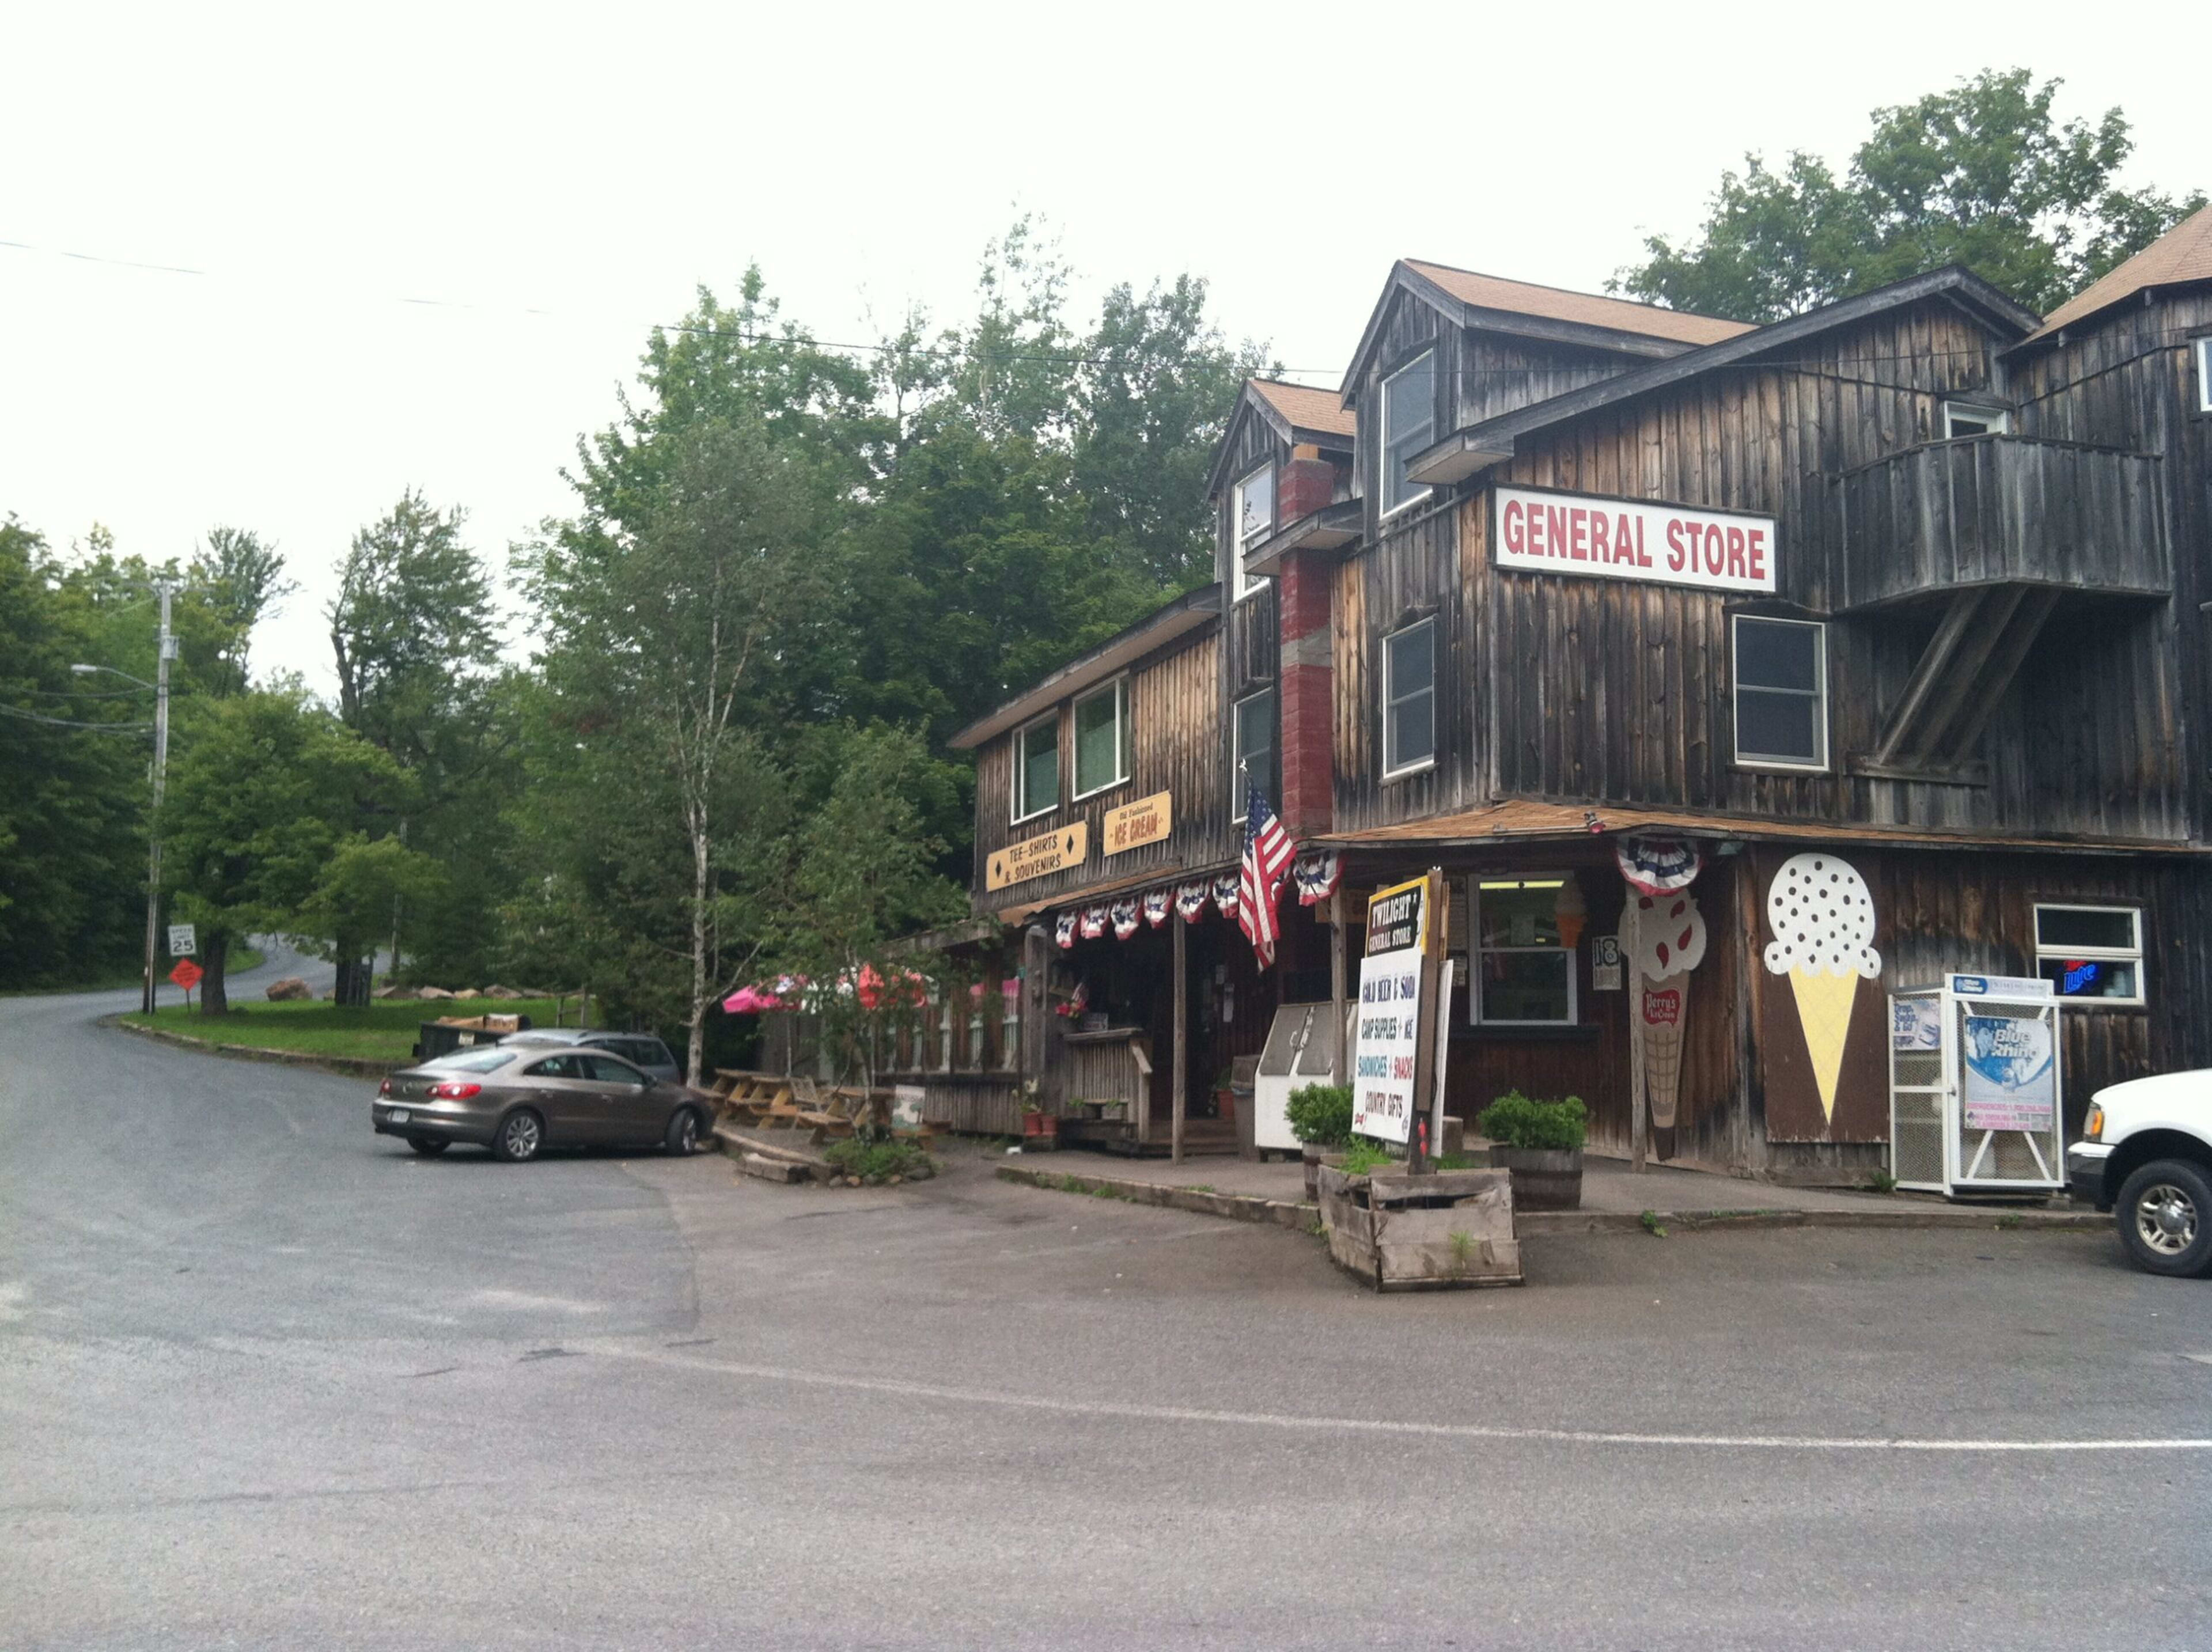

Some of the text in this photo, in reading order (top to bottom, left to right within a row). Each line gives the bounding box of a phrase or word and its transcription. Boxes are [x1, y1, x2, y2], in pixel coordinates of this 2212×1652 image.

[1504, 499, 1766, 580] GENERAL STORE
[1115, 812, 1157, 846] ICE CREAM
[1010, 834, 1057, 863] TEE-SHIRTS
[1005, 853, 1061, 883] & SOUVENIRS
[1372, 894, 1411, 929] TWILIGHT
[173, 940, 193, 953] 25
[1368, 926, 1411, 953] GENERAL STORE
[1377, 979, 1392, 1002] BEER
[1400, 975, 1415, 999] SODA
[1646, 994, 1676, 1014] Perry's
[1362, 1018, 1374, 1040] CAMP
[1374, 1017, 1396, 1040] SUPPLIES
[1995, 1029, 2032, 1043] Blue
[1991, 1043, 2038, 1058] Rhino
[1358, 1055, 1387, 1078] SANDWICHES
[1393, 1056, 1413, 1080] SNACKS
[1365, 1091, 1403, 1119] COUNTRY GIFTS
